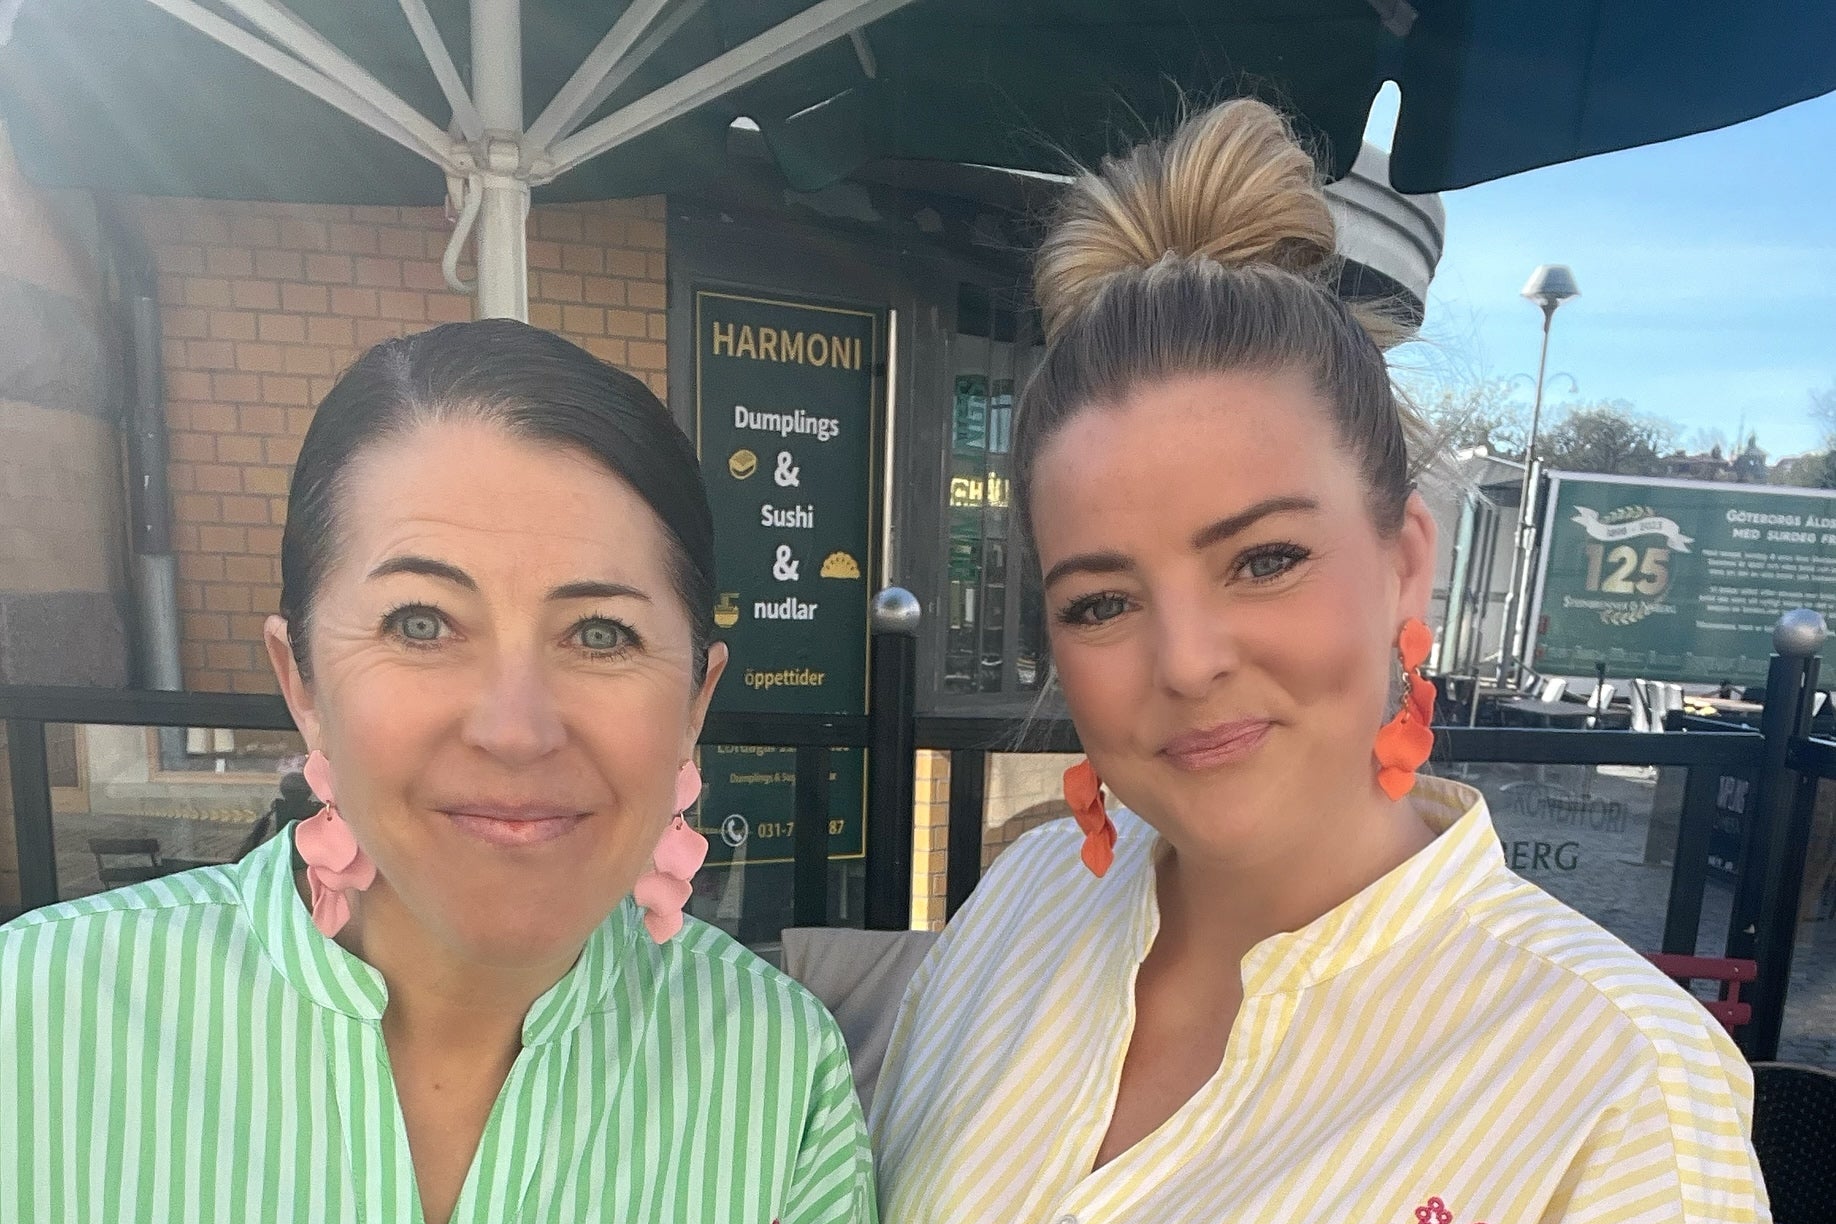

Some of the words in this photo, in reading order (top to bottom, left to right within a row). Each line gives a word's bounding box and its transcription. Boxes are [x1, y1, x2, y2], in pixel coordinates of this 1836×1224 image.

[712, 321, 862, 371] HARMONI
[734, 405, 840, 441] Dumplings
[774, 451, 800, 487] &
[760, 503, 814, 529] Sushi
[772, 544, 800, 582] &
[1585, 543, 1671, 595] 125
[754, 597, 818, 620] nudlar
[745, 668, 825, 690] öppettider
[828, 819, 845, 836] 87
[1502, 840, 1580, 872] ERG
